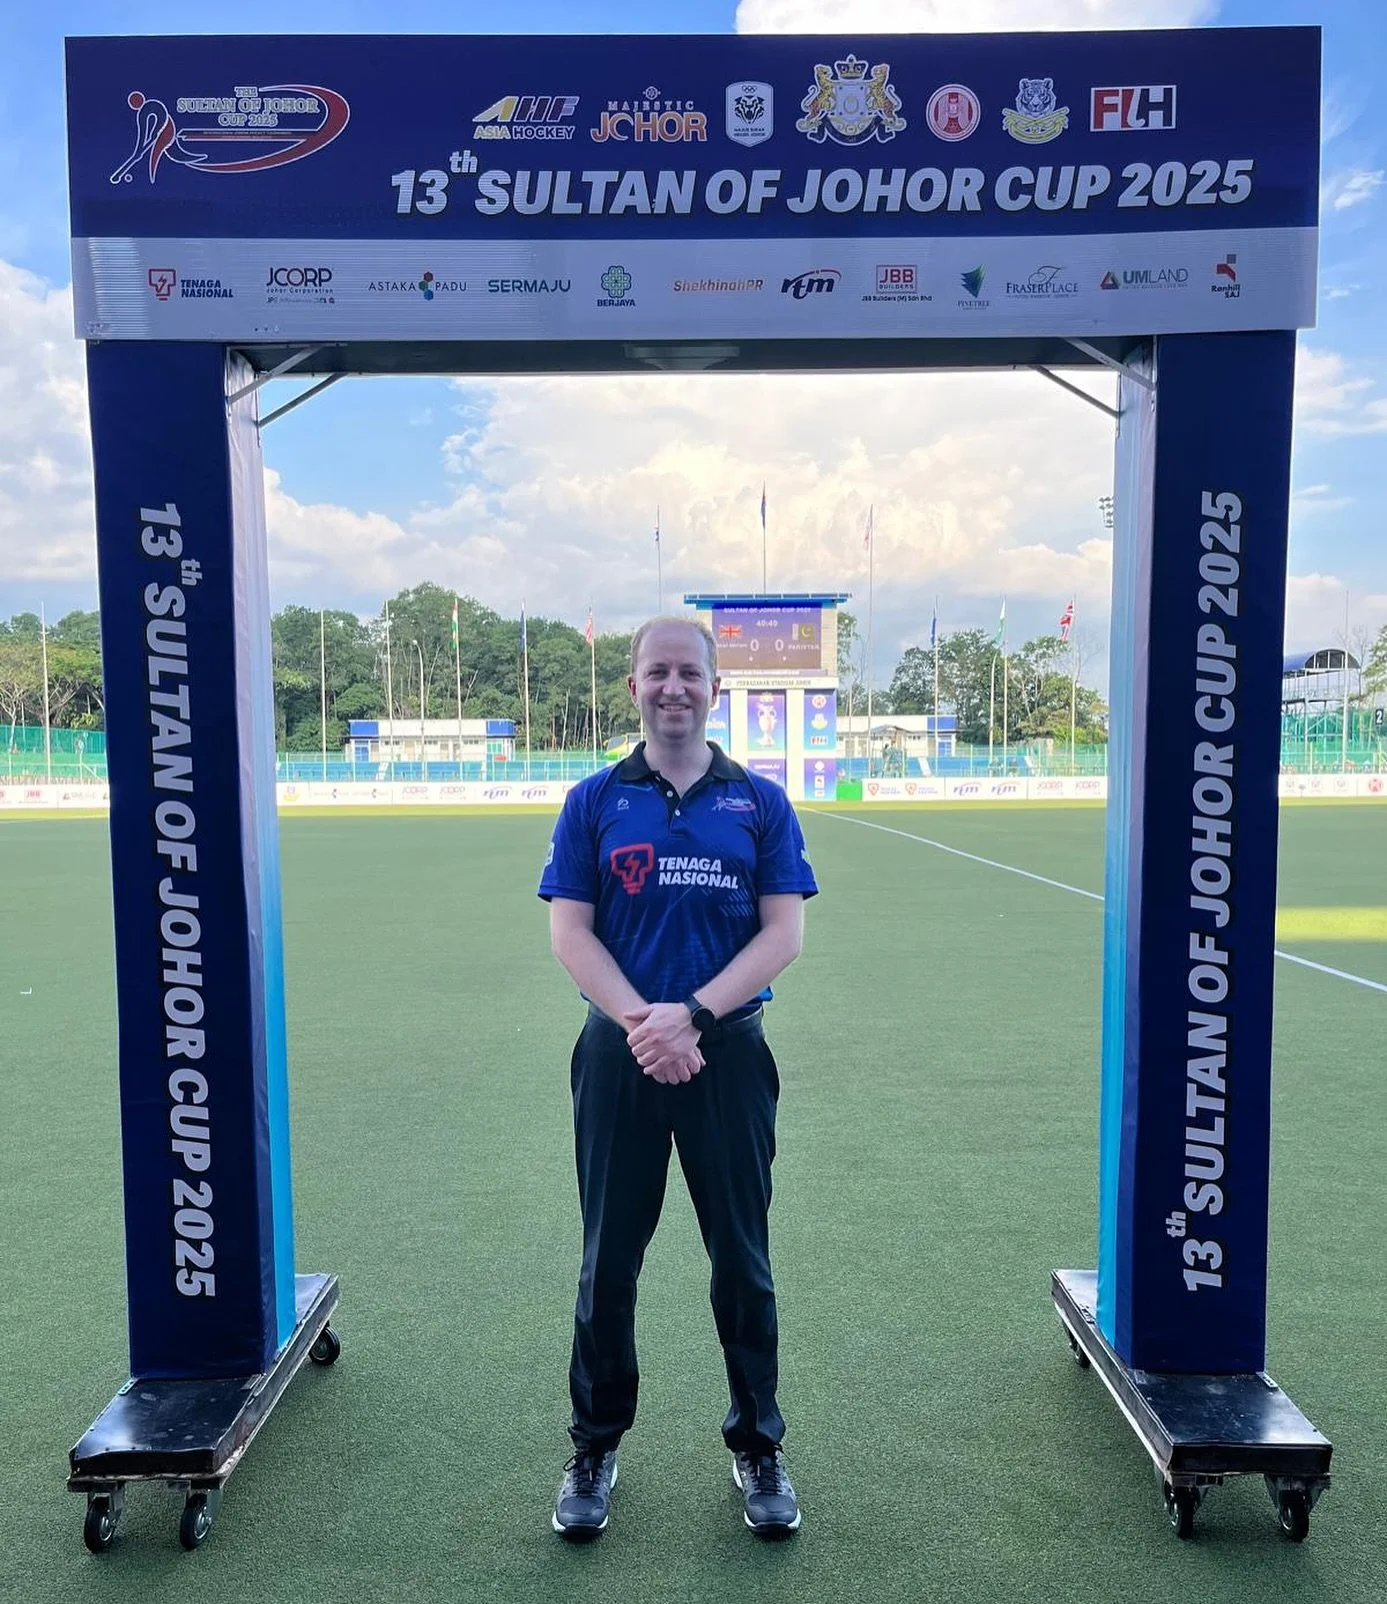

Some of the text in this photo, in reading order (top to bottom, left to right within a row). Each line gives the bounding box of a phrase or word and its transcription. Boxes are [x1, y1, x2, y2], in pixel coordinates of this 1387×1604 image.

[234, 87, 258, 97] THE
[177, 98, 320, 114] SULTAN OF JOHOR
[608, 100, 694, 111] MAJESTIC
[218, 113, 247, 126] CUP
[473, 125, 575, 139] ASIA HOCKEY
[474, 170, 697, 214] SULTAN
[705, 169, 781, 214] OF
[787, 166, 985, 213] JOHOR
[994, 165, 1111, 211] CUP
[1117, 160, 1255, 208] 2025
[266, 267, 332, 287] JCORP
[879, 268, 914, 283] JBB
[1123, 268, 1189, 284] UMLAND
[181, 279, 221, 288] TENAGA
[368, 281, 467, 292] ASTAKA PADU
[488, 280, 571, 293] SERMAJU
[673, 279, 764, 292] ShekhinahPR
[181, 289, 233, 298] NASIONAL
[597, 299, 636, 307] BERJAYA
[1198, 491, 1242, 617] 2025
[750, 639, 759, 651] 0
[775, 639, 784, 651] 0
[1194, 623, 1238, 733] CUP
[144, 582, 194, 792] SULTAN
[1376, 710, 1382, 723] 2
[155, 800, 198, 872] OF
[1190, 741, 1235, 928] JOHOR
[658, 857, 722, 872] TENAGA
[658, 872, 738, 889] NASIONAL
[158, 876, 206, 1060] JOHOR
[1188, 931, 1230, 1004] OF
[168, 1068, 210, 1172] CUP
[1184, 1010, 1228, 1216] SULTAN
[173, 1179, 215, 1297] 2025
